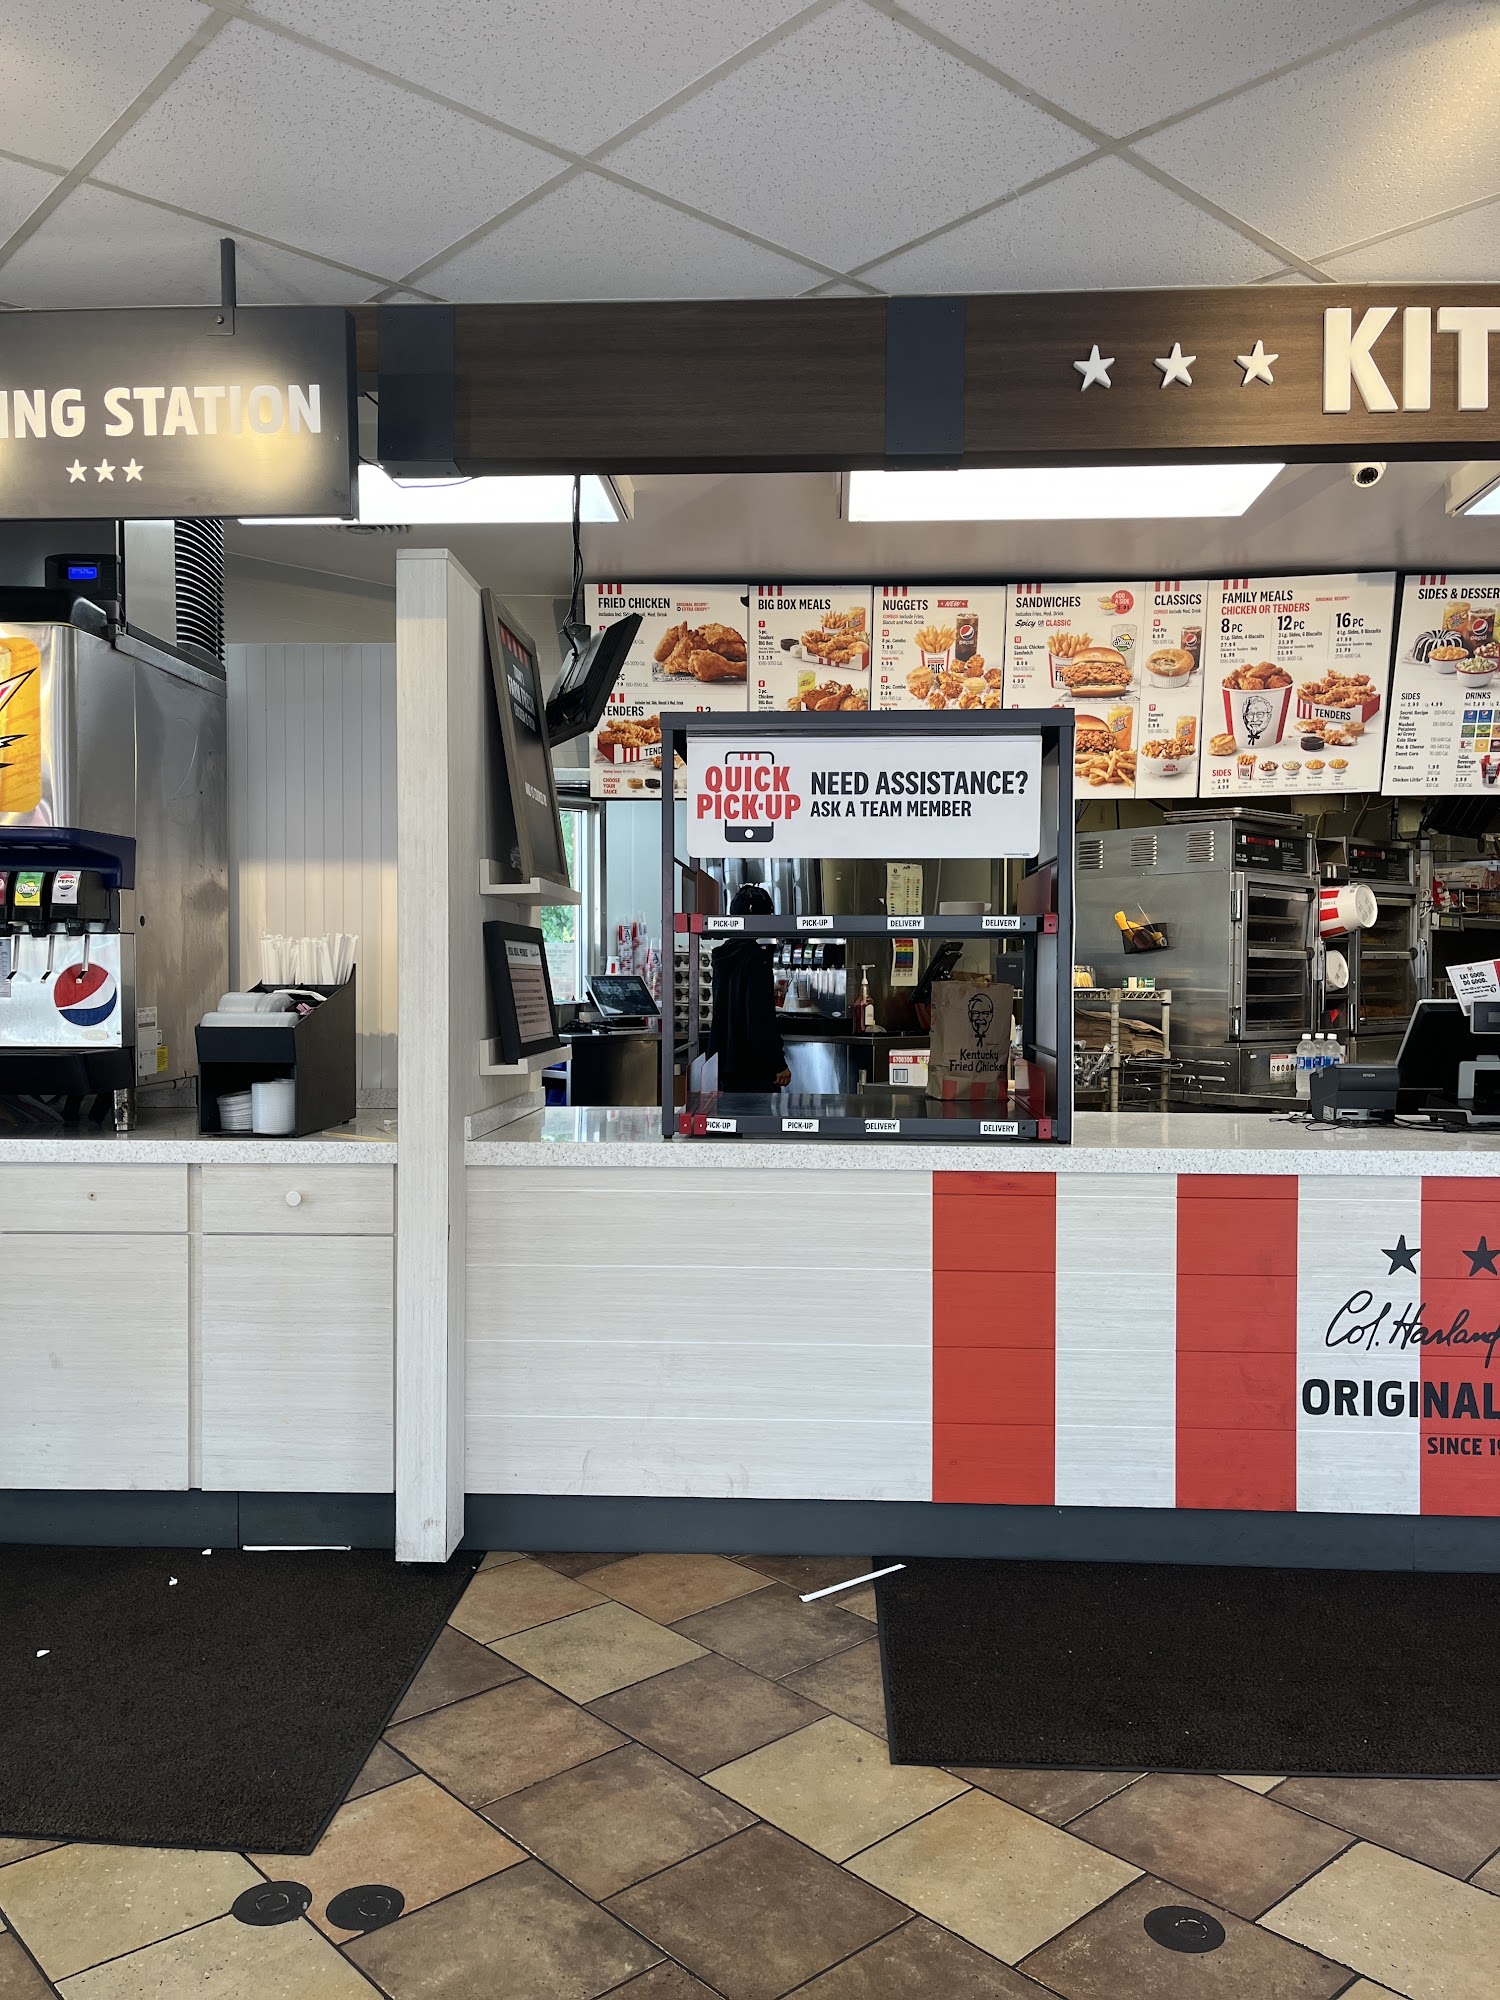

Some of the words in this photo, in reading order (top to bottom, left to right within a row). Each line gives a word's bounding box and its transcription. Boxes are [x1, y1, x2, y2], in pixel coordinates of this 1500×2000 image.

[1323, 306, 1500, 414] KIT
[103, 383, 322, 437] STATION
[1222, 591, 1258, 604] FAMILY
[1260, 590, 1293, 602] MEALS
[1418, 588, 1447, 599] SIDES
[1450, 588, 1458, 599] &
[1461, 588, 1500, 599] DESSER
[598, 598, 625, 608] FRIED
[628, 598, 670, 608] CHICKEN
[758, 599, 775, 610] BIG
[777, 599, 796, 610] BOX
[799, 599, 831, 610] MEALS
[882, 600, 928, 611] NUGGETS
[1015, 596, 1081, 608] SANDWICHES
[1155, 594, 1202, 606] CLASSICS
[1221, 604, 1257, 615] CHICKEN
[1259, 603, 1271, 614] OR
[1273, 602, 1310, 613] TENDERS
[1015, 619, 1036, 628] Spicy
[1221, 618, 1230, 633] 8
[1232, 624, 1242, 632] PC
[1278, 615, 1292, 630] 12
[1294, 621, 1304, 629] PC
[1336, 612, 1351, 628] 16
[1353, 618, 1364, 627] PC
[1315, 708, 1351, 721] TENDERS
[1212, 769, 1232, 777] SIDES
[704, 765, 791, 794] QUICK
[810, 771, 869, 796] NEED
[875, 770, 1029, 796] ASSISTANCE?
[810, 801, 841, 817] ASK
[845, 801, 857, 817] A
[859, 801, 902, 817] TEAM
[906, 801, 972, 817] MEMBER
[713, 920, 739, 928] PICK-UP
[802, 919, 828, 927] PICK-UP
[890, 919, 921, 927] DELIVERY
[985, 919, 1017, 927] DELIVERY
[960, 1049, 999, 1062] Kentucky
[949, 1060, 973, 1071] Fried
[706, 1121, 731, 1130] PICK-UP
[787, 1121, 814, 1130] PICK-UP
[866, 1121, 898, 1131] DELIVERY
[1326, 1290, 1392, 1351] Col.
[1302, 1379, 1500, 1420] ORIGINAL
[1427, 1437, 1482, 1456] SINCE
